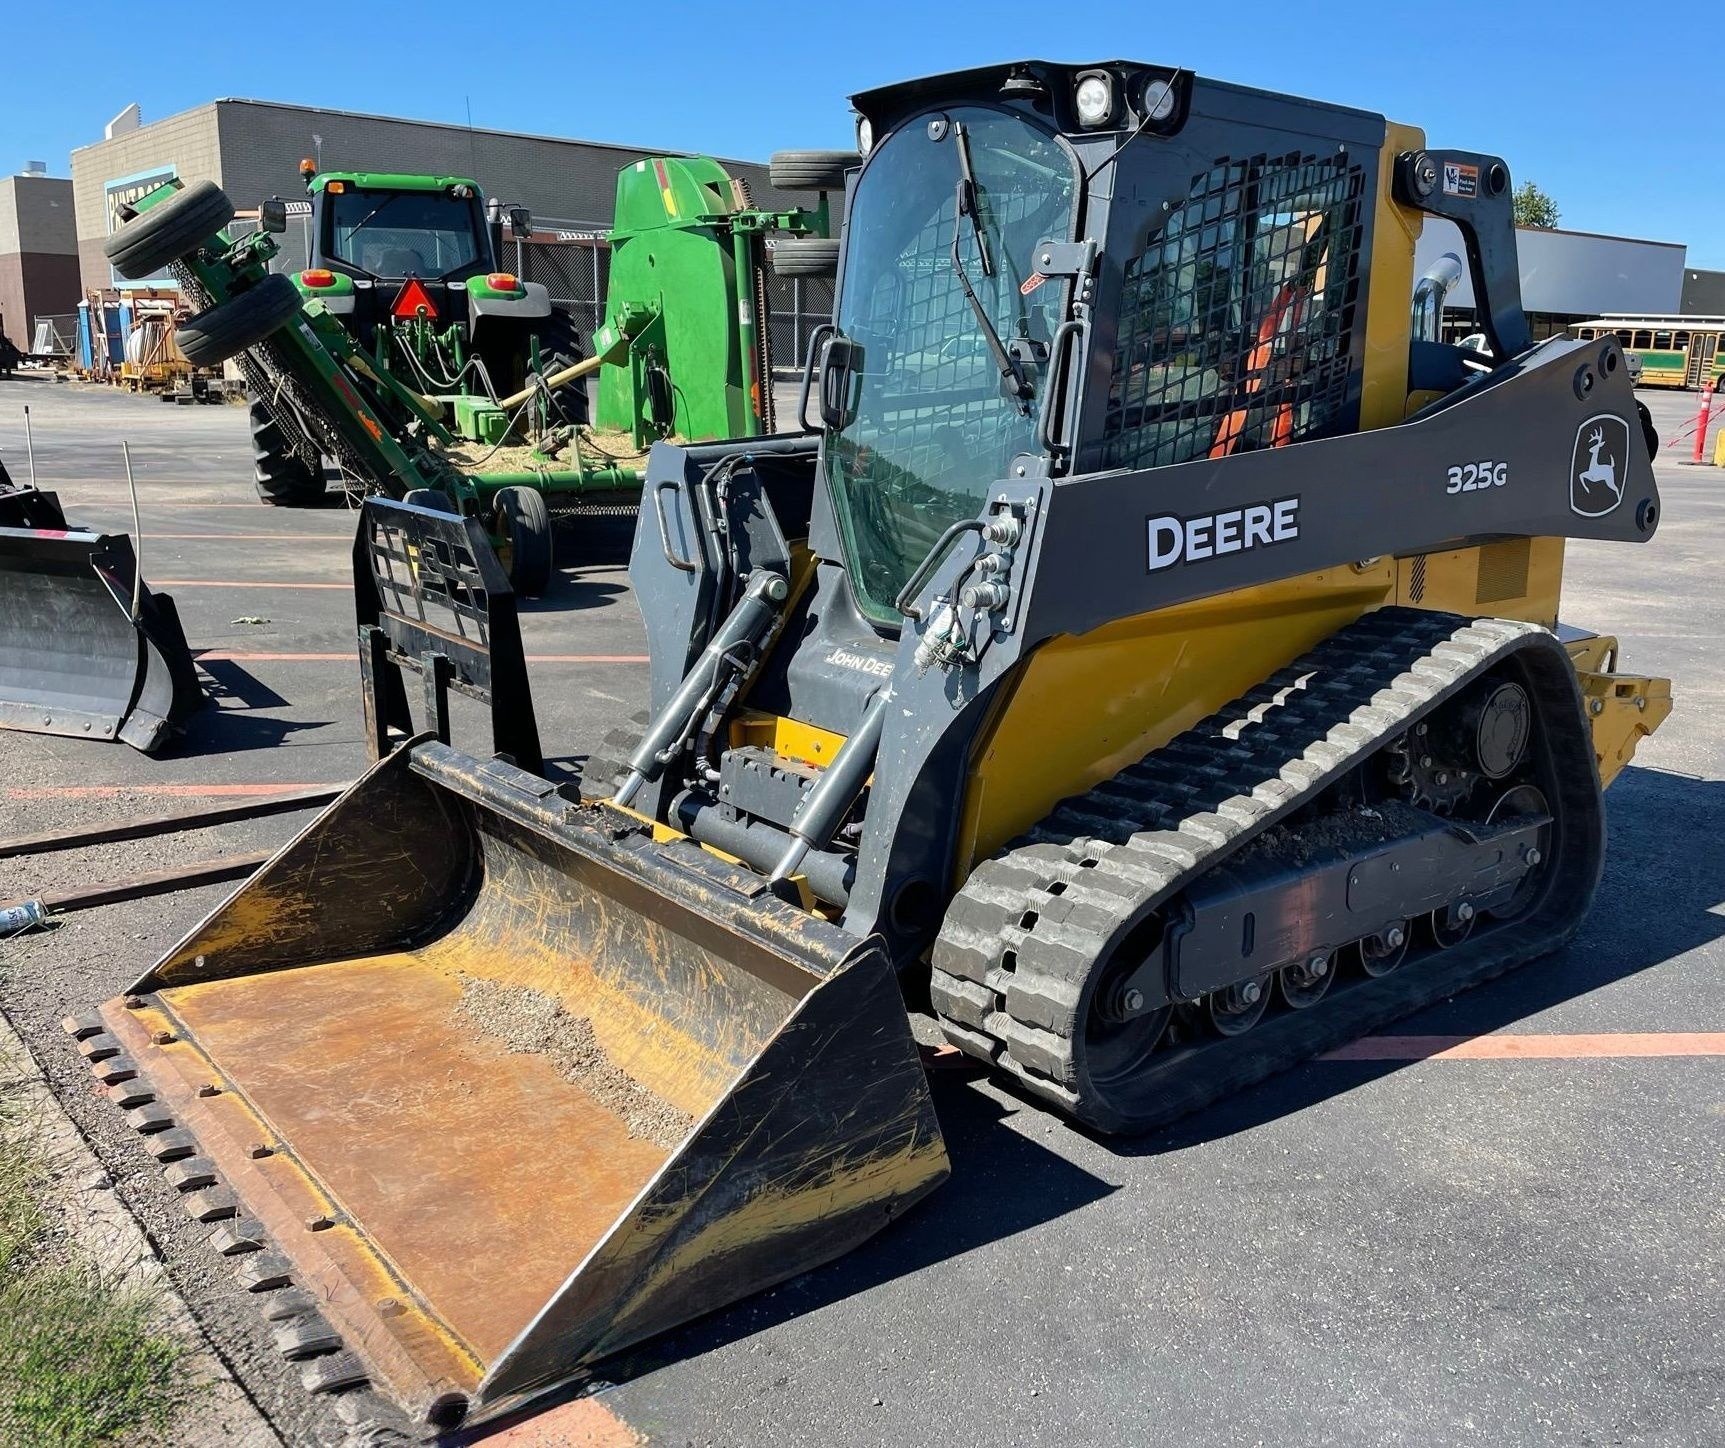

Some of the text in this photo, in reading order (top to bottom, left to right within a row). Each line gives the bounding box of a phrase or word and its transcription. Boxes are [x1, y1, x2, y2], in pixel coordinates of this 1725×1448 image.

[1446, 461, 1508, 494] 325G
[1148, 498, 1299, 571] DEERE
[825, 647, 864, 670] JOHN
